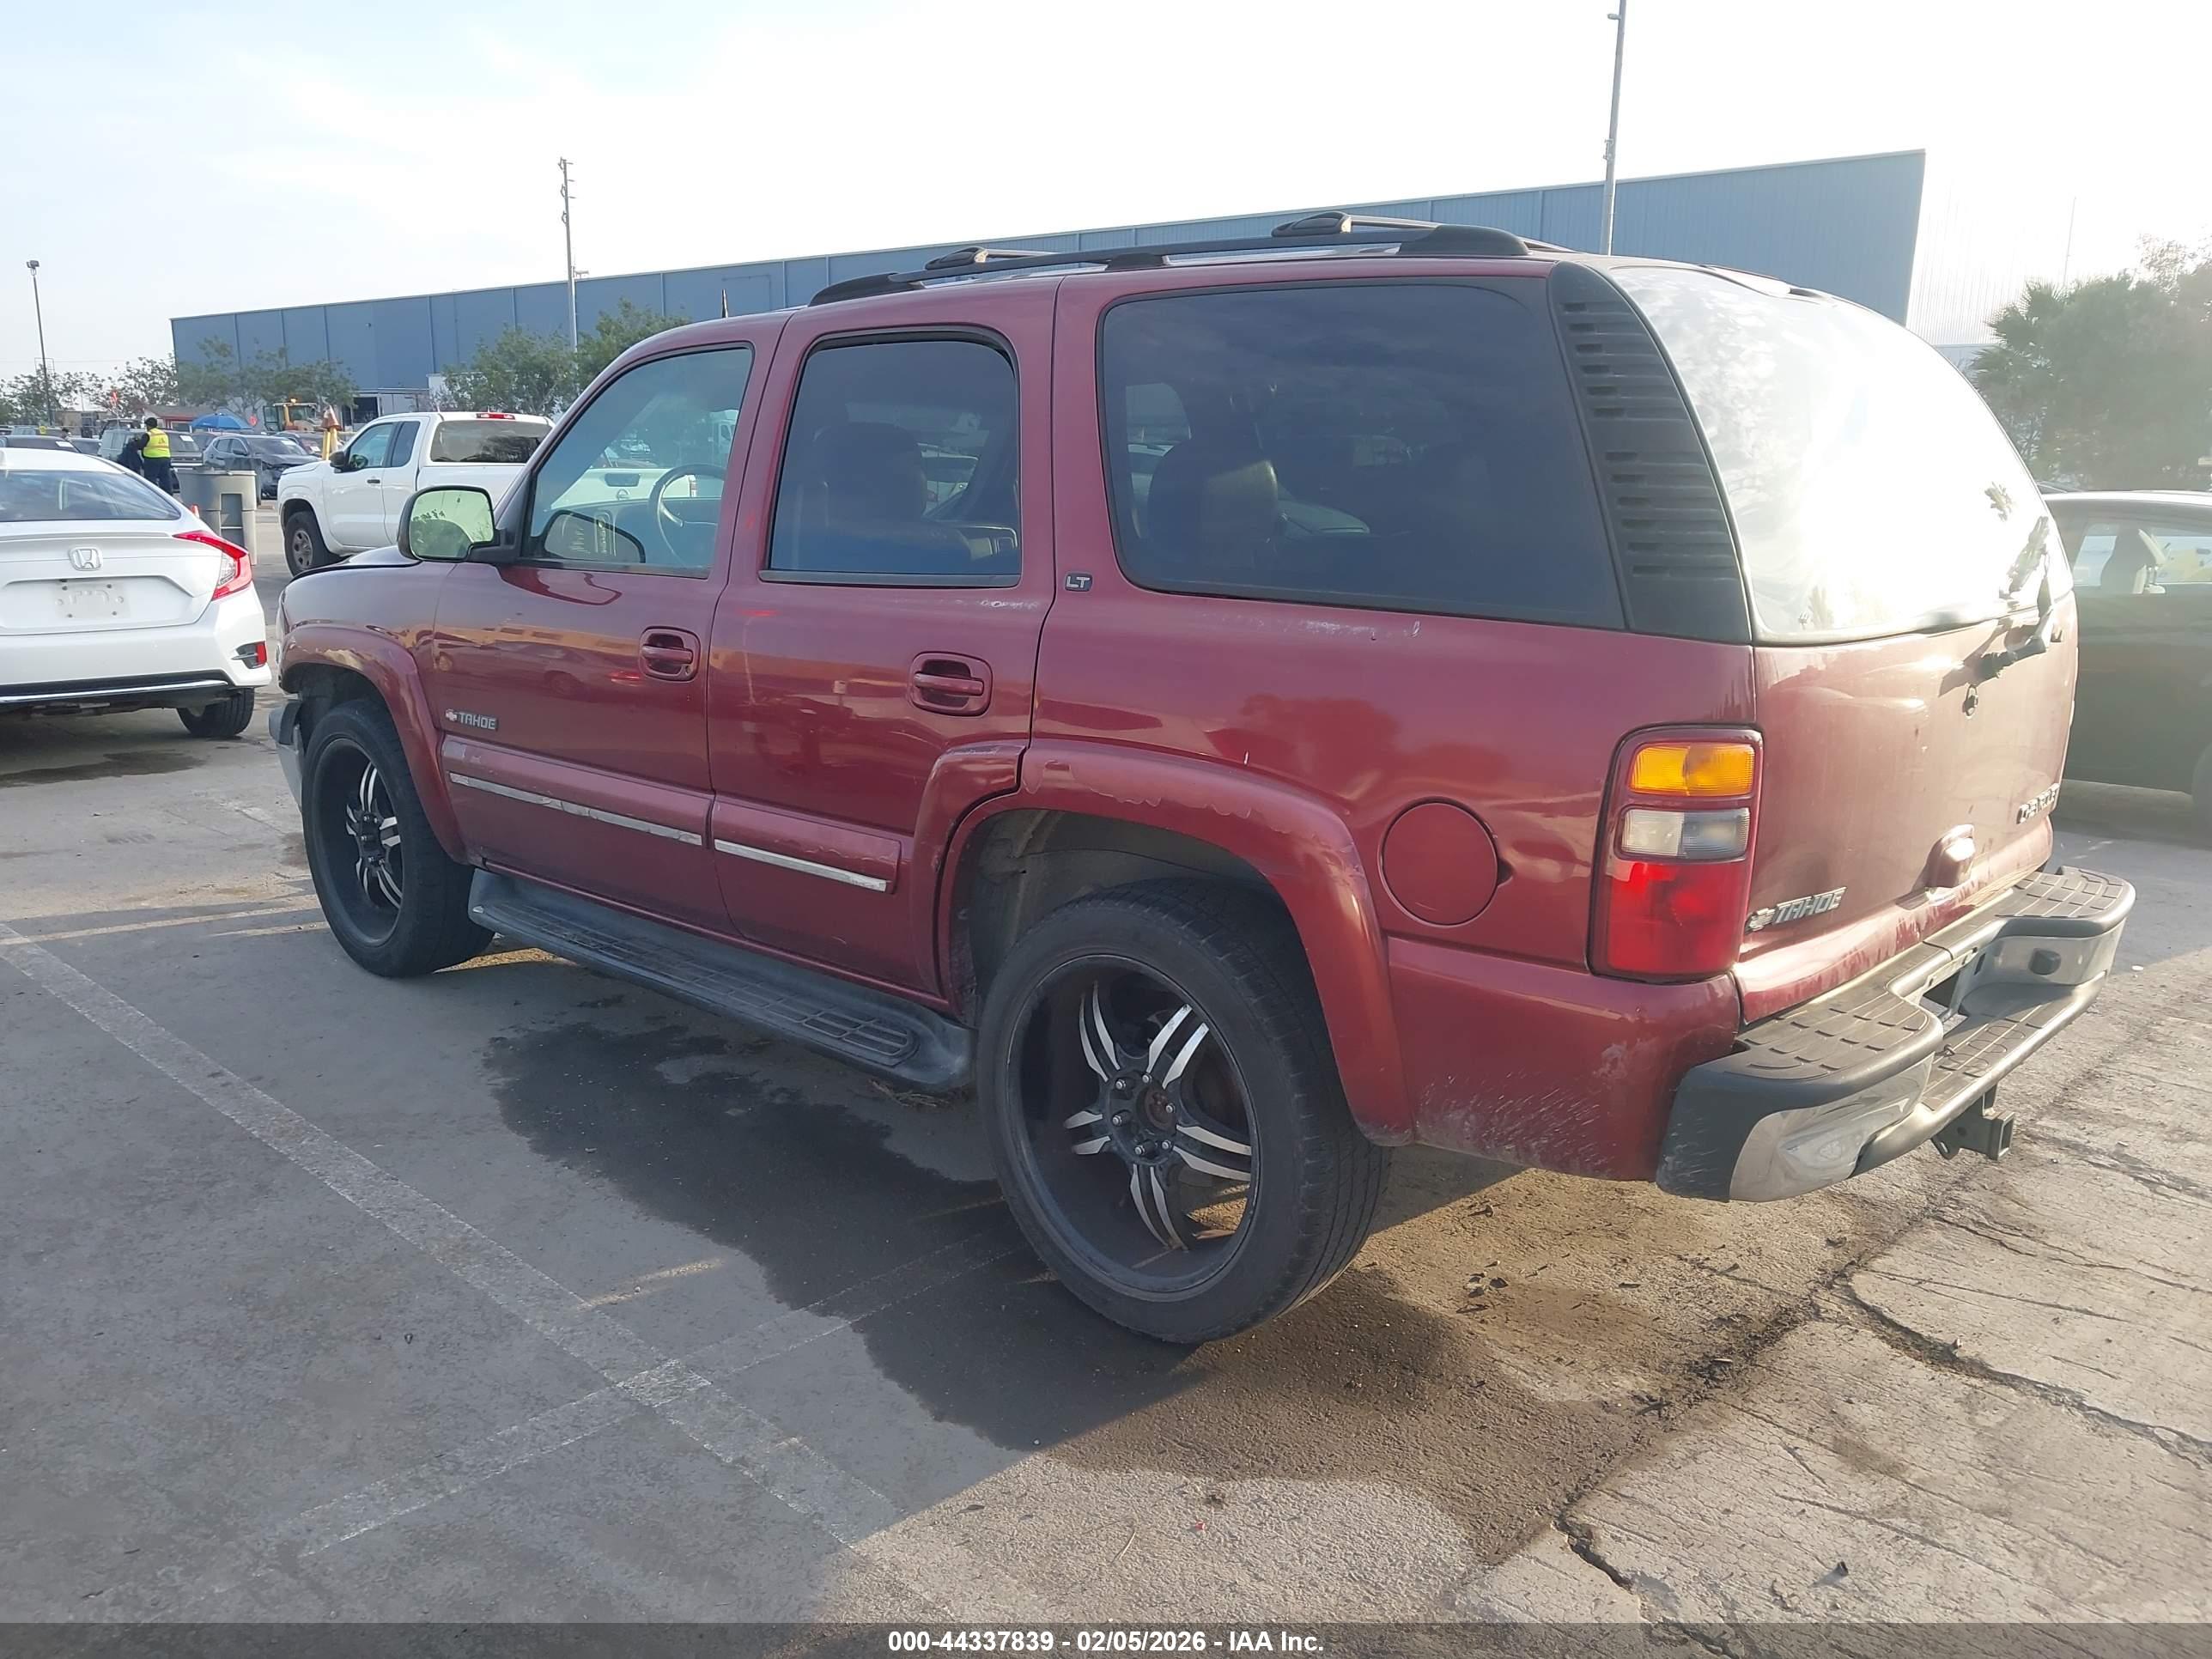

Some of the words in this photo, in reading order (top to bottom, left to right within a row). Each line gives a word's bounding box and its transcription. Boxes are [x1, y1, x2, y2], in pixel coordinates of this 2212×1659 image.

[1066, 576, 1091, 588] LT
[459, 712, 496, 730] TAHOE
[1774, 886, 1847, 924] TAHOE
